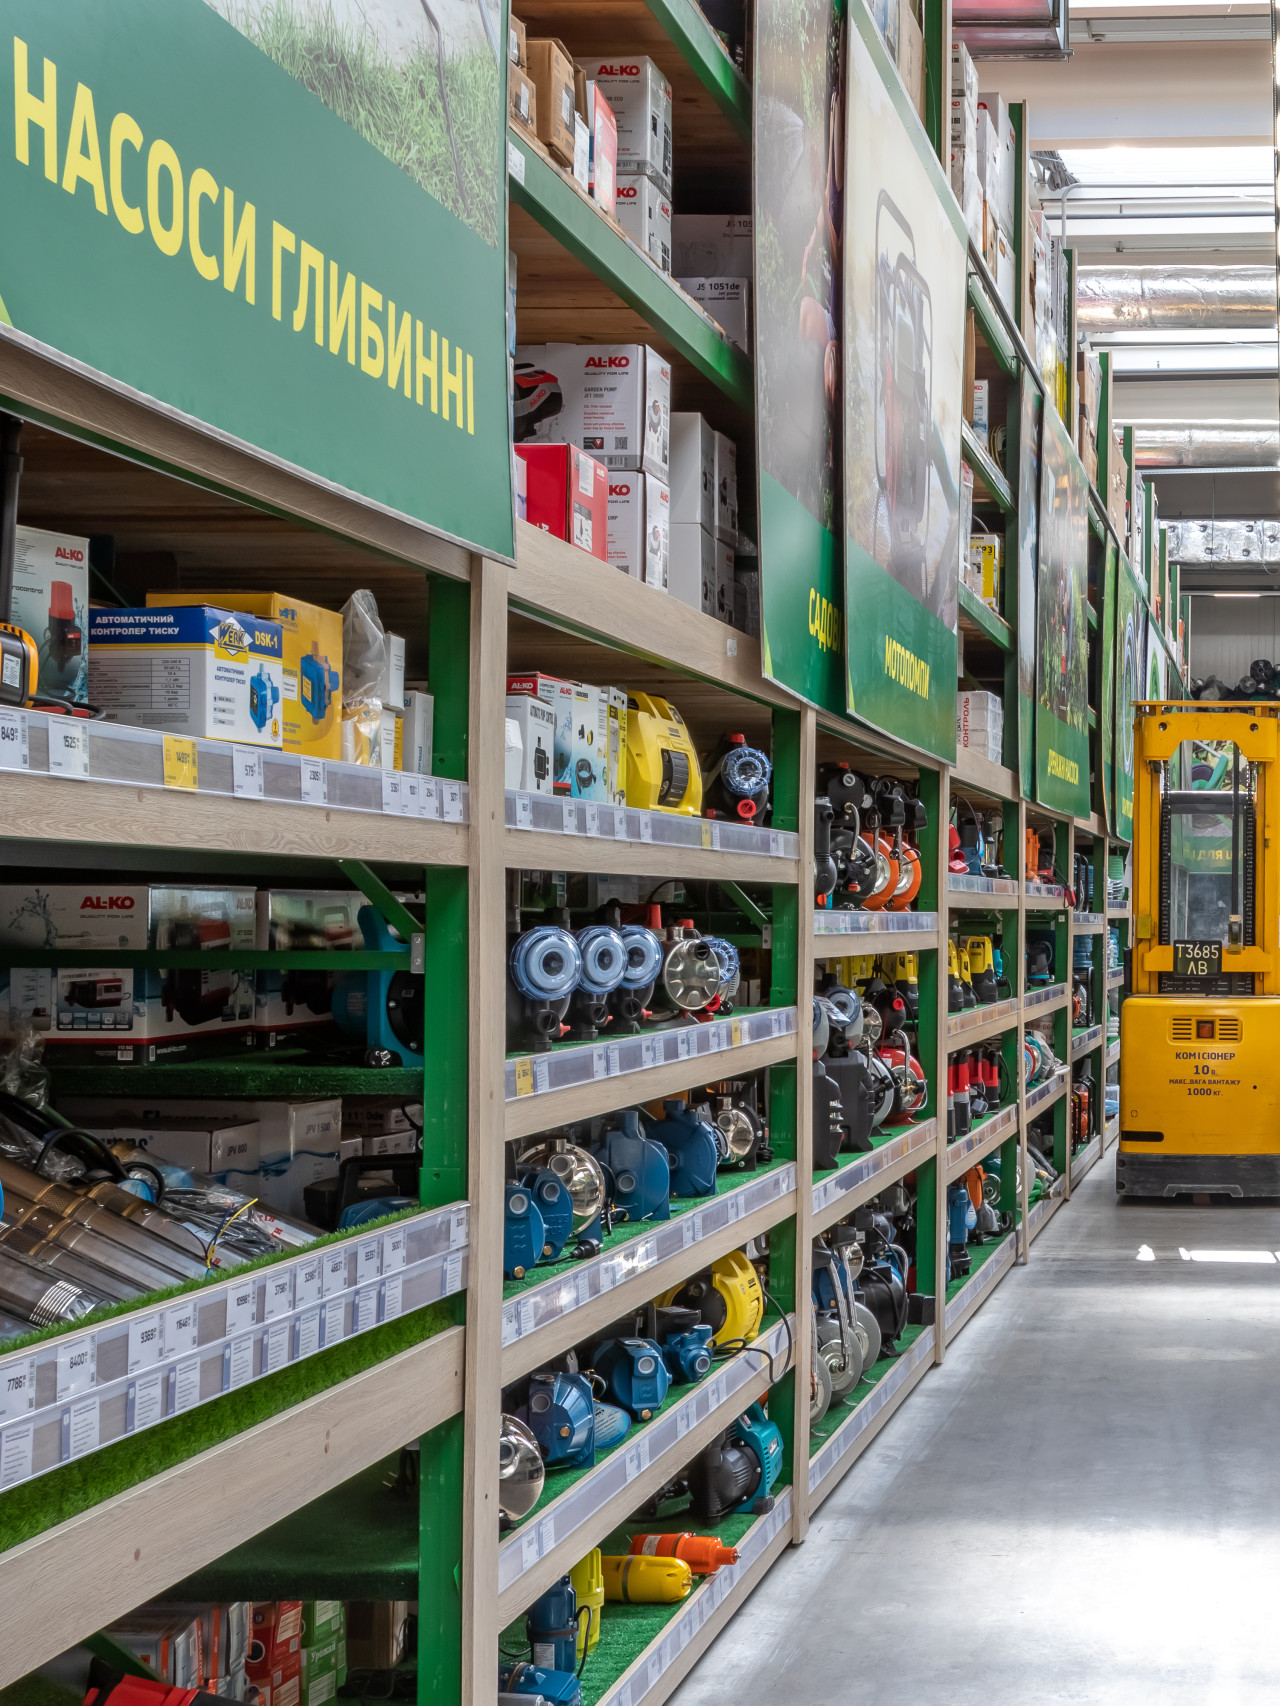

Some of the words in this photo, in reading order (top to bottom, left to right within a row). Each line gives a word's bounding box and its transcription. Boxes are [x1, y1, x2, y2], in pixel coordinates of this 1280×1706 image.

[597, 65, 640, 76] AL-KO
[13, 35, 256, 305] НАСОСИ
[272, 220, 475, 436] ГЛИБИННІ
[584, 356, 630, 368] AL-KO
[55, 546, 84, 562] AL-KO
[96, 614, 174, 624] АВТОМАТИЧНИЙ
[91, 627, 146, 636] КОНТРОЛЕР
[149, 627, 179, 635] ТИСКУ
[255, 630, 278, 649] DSK-1
[885, 634, 929, 700] МОТОПОМПИ
[80, 896, 135, 910] AL-KO
[1176, 1052, 1236, 1061] КОМІСІОНЕР
[1194, 1065, 1210, 1075] 10
[1187, 1088, 1212, 1096] 1000
[227, 1145, 238, 1157] JPV
[70, 1352, 85, 1369] 8400
[7, 1377, 22, 1391] 7786
